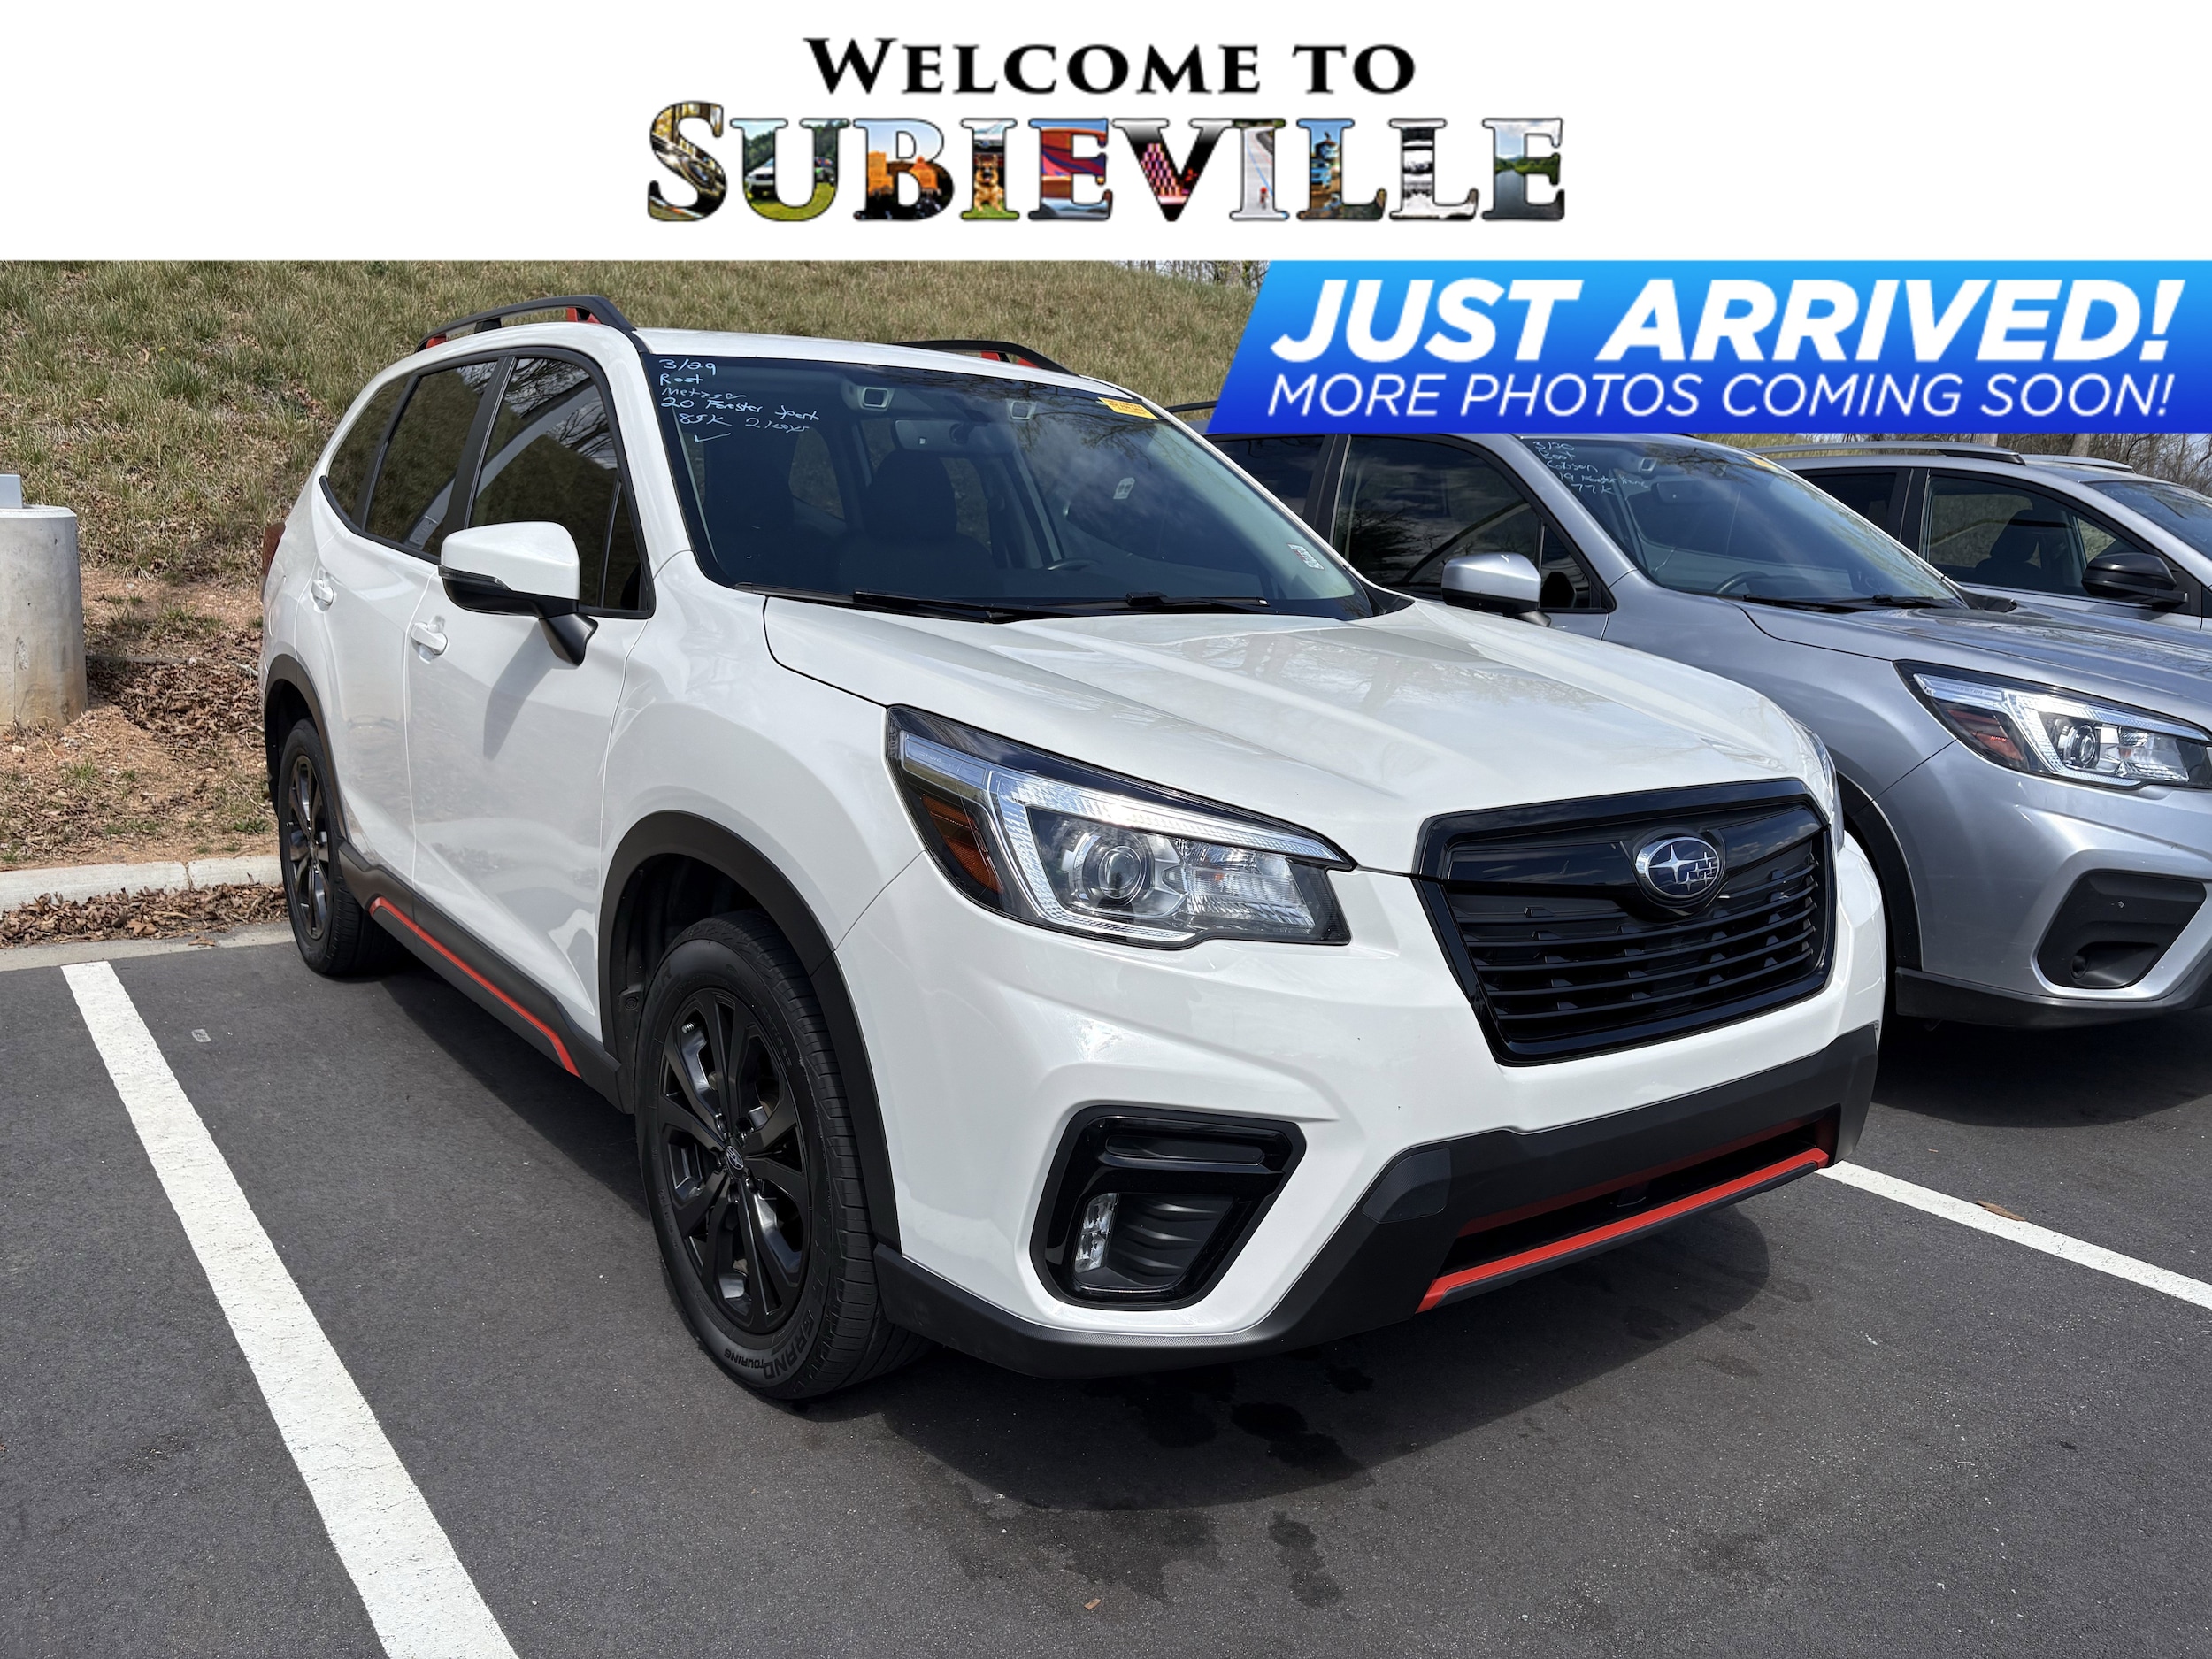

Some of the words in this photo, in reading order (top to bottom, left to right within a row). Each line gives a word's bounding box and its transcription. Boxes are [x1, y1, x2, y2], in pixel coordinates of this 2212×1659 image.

[658, 358, 717, 376] 3/29
[660, 397, 695, 408] 20
[763, 1309, 815, 1380] GRAND
[724, 1348, 764, 1370] TOURING
